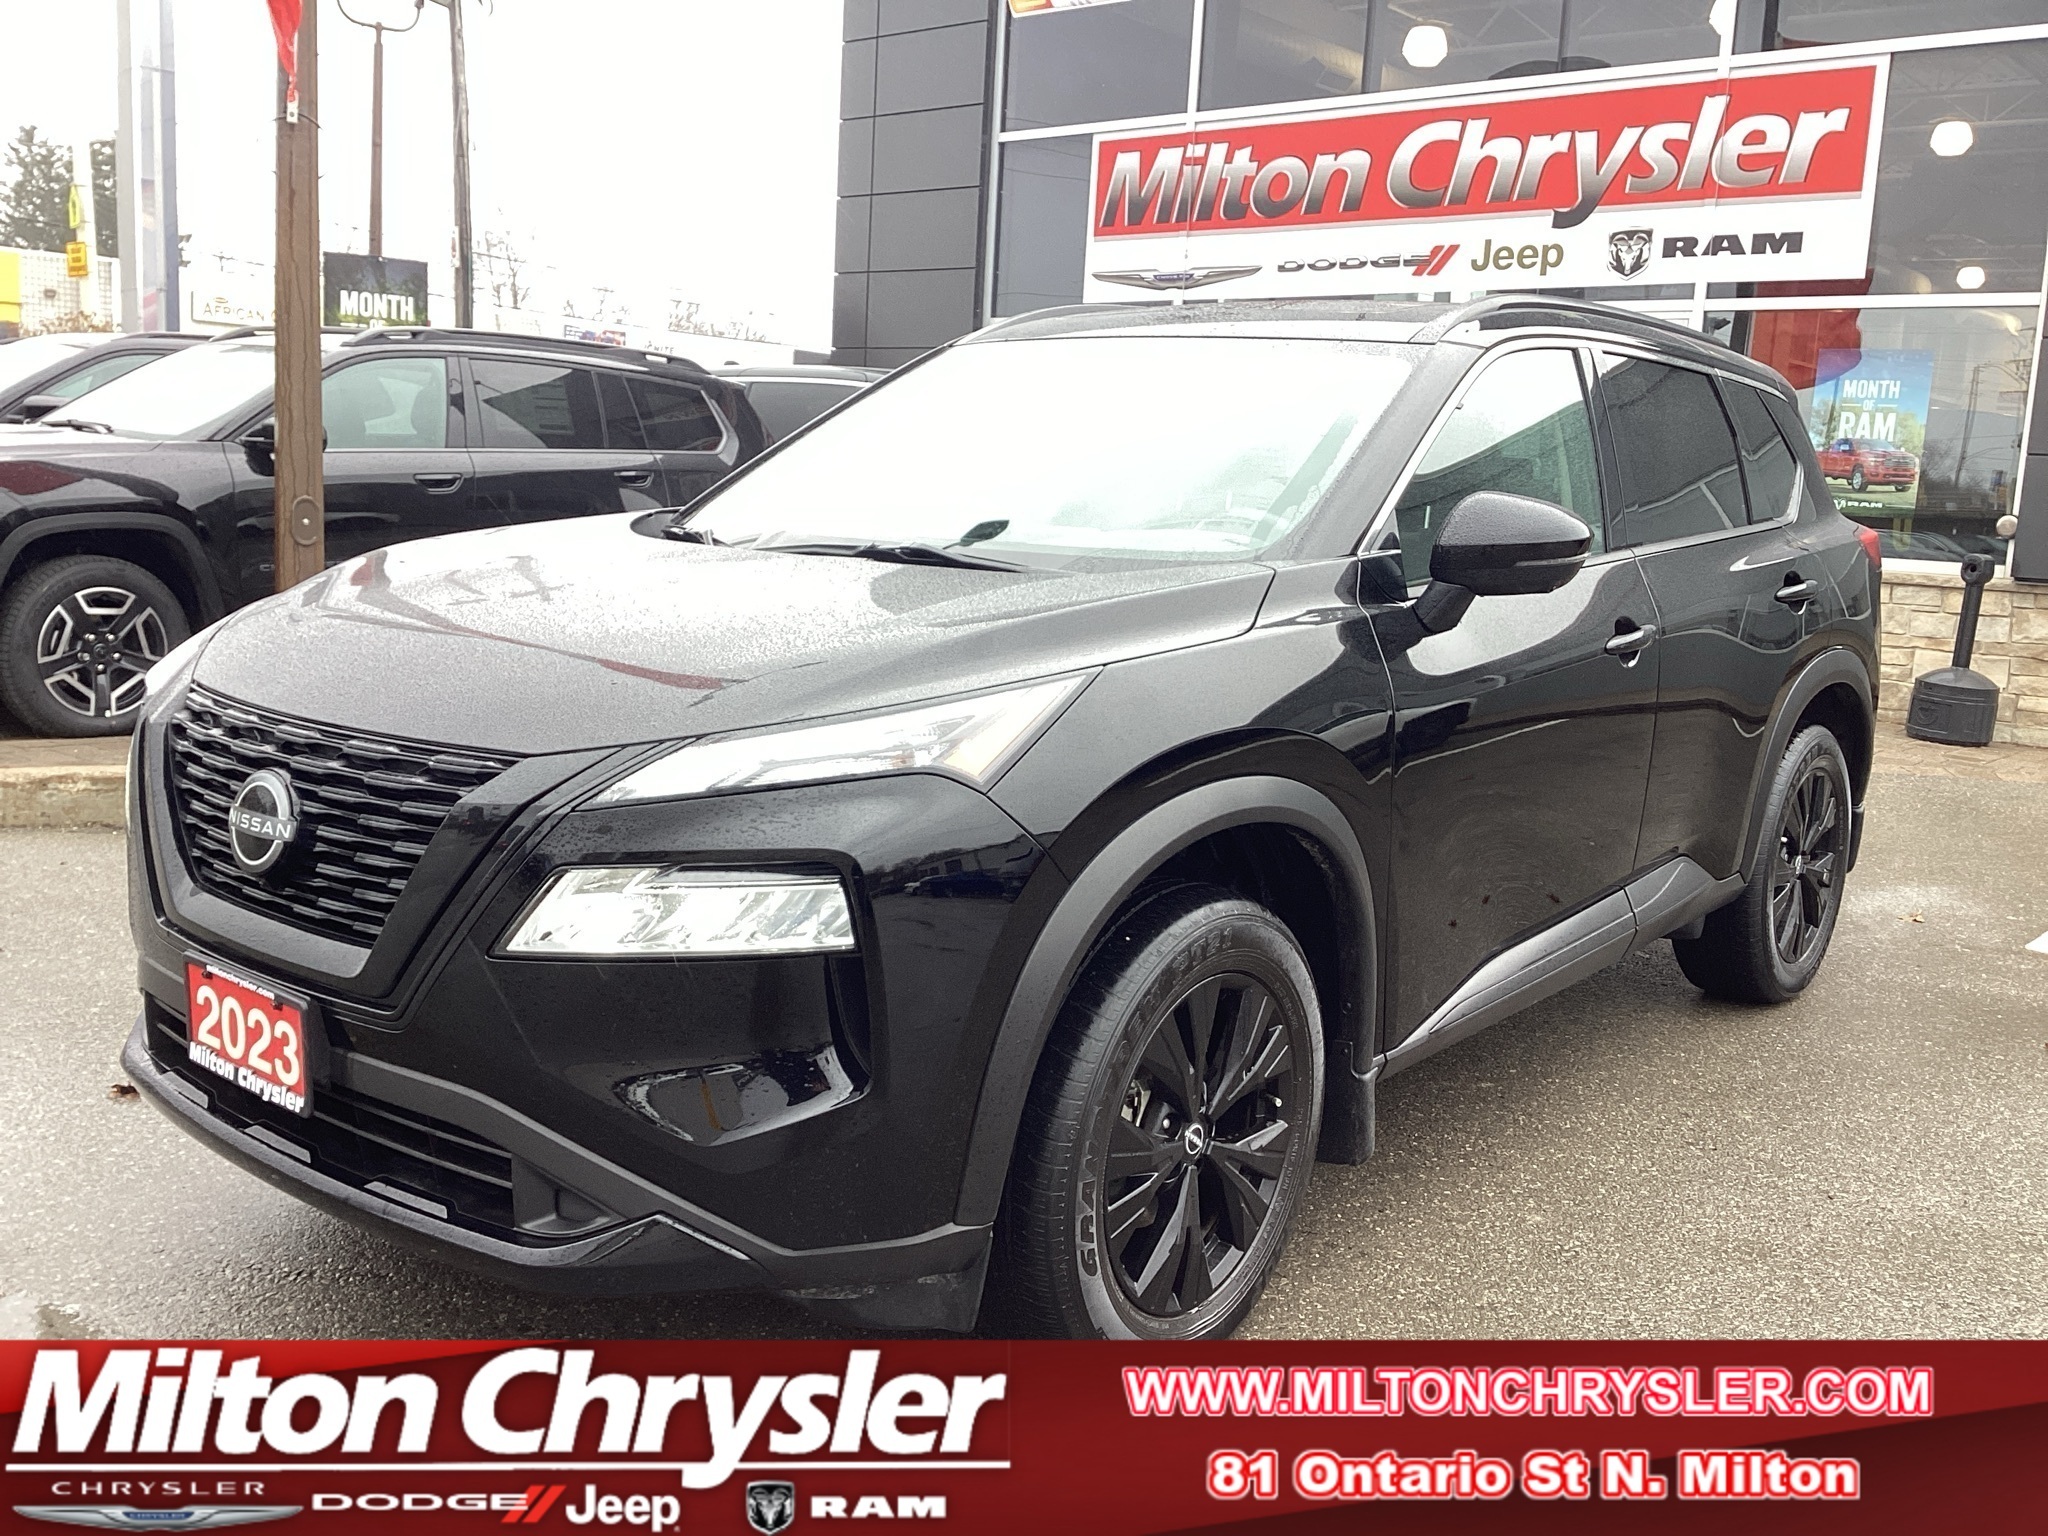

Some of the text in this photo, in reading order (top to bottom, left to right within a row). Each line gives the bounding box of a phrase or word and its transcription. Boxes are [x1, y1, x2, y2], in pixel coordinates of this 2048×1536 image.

[1099, 95, 1852, 230] Milton Chrysler
[1470, 239, 1564, 276] Jeep
[1661, 231, 1804, 259] RAM
[1277, 252, 1432, 272] DODGE
[203, 302, 265, 322] AFRICAN
[339, 289, 415, 322] MONTH
[1842, 379, 1901, 399] MONTH
[1862, 400, 1875, 411] OF
[1838, 411, 1897, 442] RAM
[229, 808, 291, 838] NISSAN
[196, 985, 300, 1086] 2023
[189, 1041, 305, 1114] Milton Chrysler
